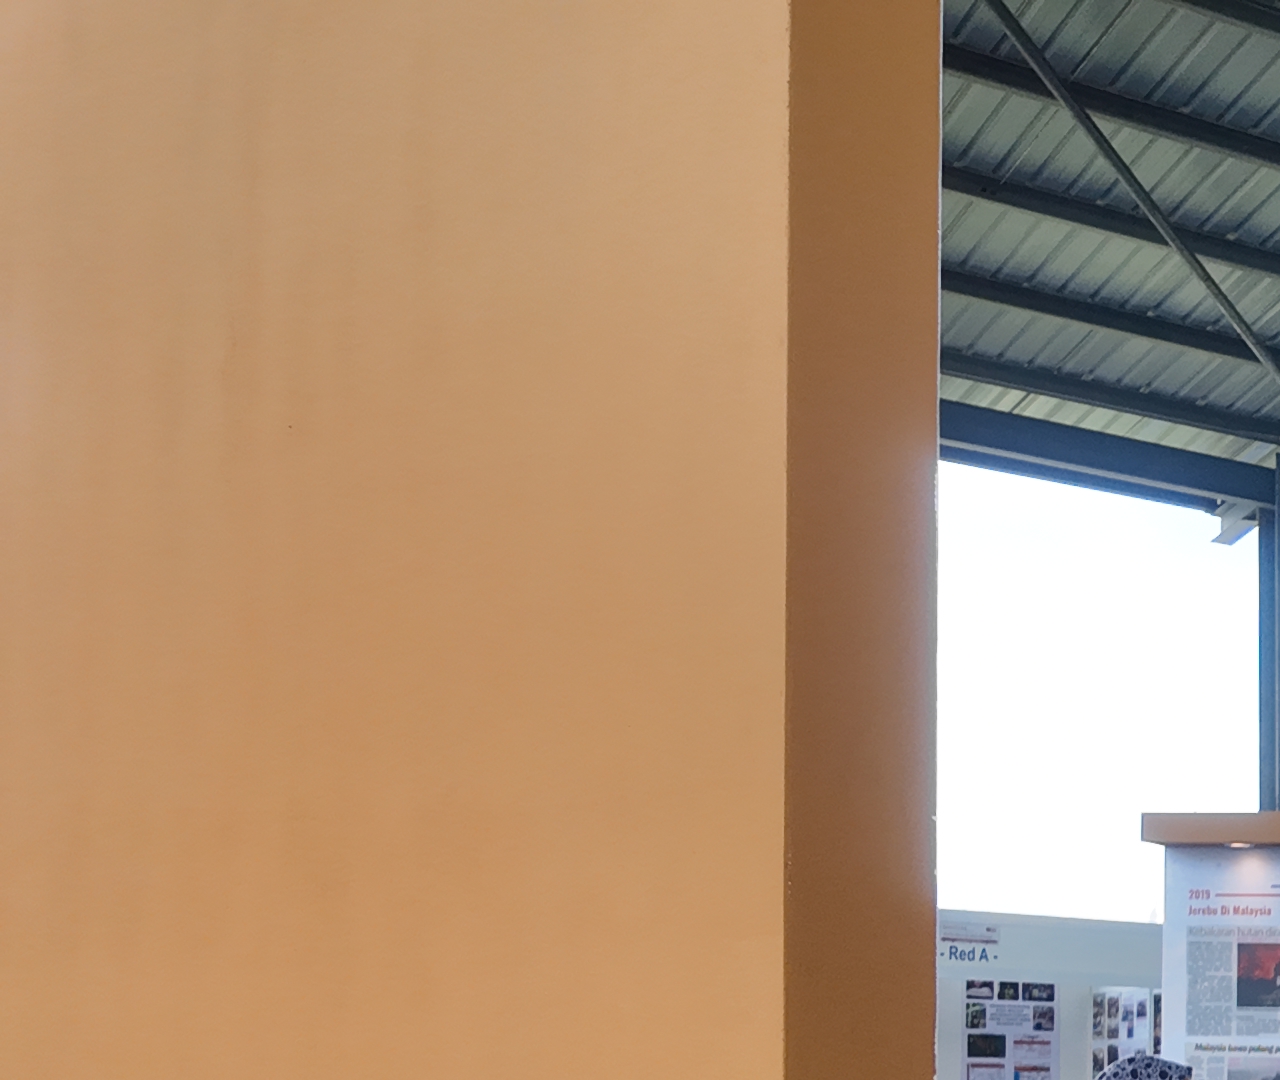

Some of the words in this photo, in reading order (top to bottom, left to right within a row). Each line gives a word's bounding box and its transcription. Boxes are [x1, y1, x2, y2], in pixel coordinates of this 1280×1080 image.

[1188, 889, 1210, 900] 2019
[1188, 905, 1218, 916] Jerebu
[1221, 905, 1230, 916] Di
[1233, 905, 1272, 918] Malaysia
[949, 946, 975, 961] Red
[979, 948, 988, 962] A
